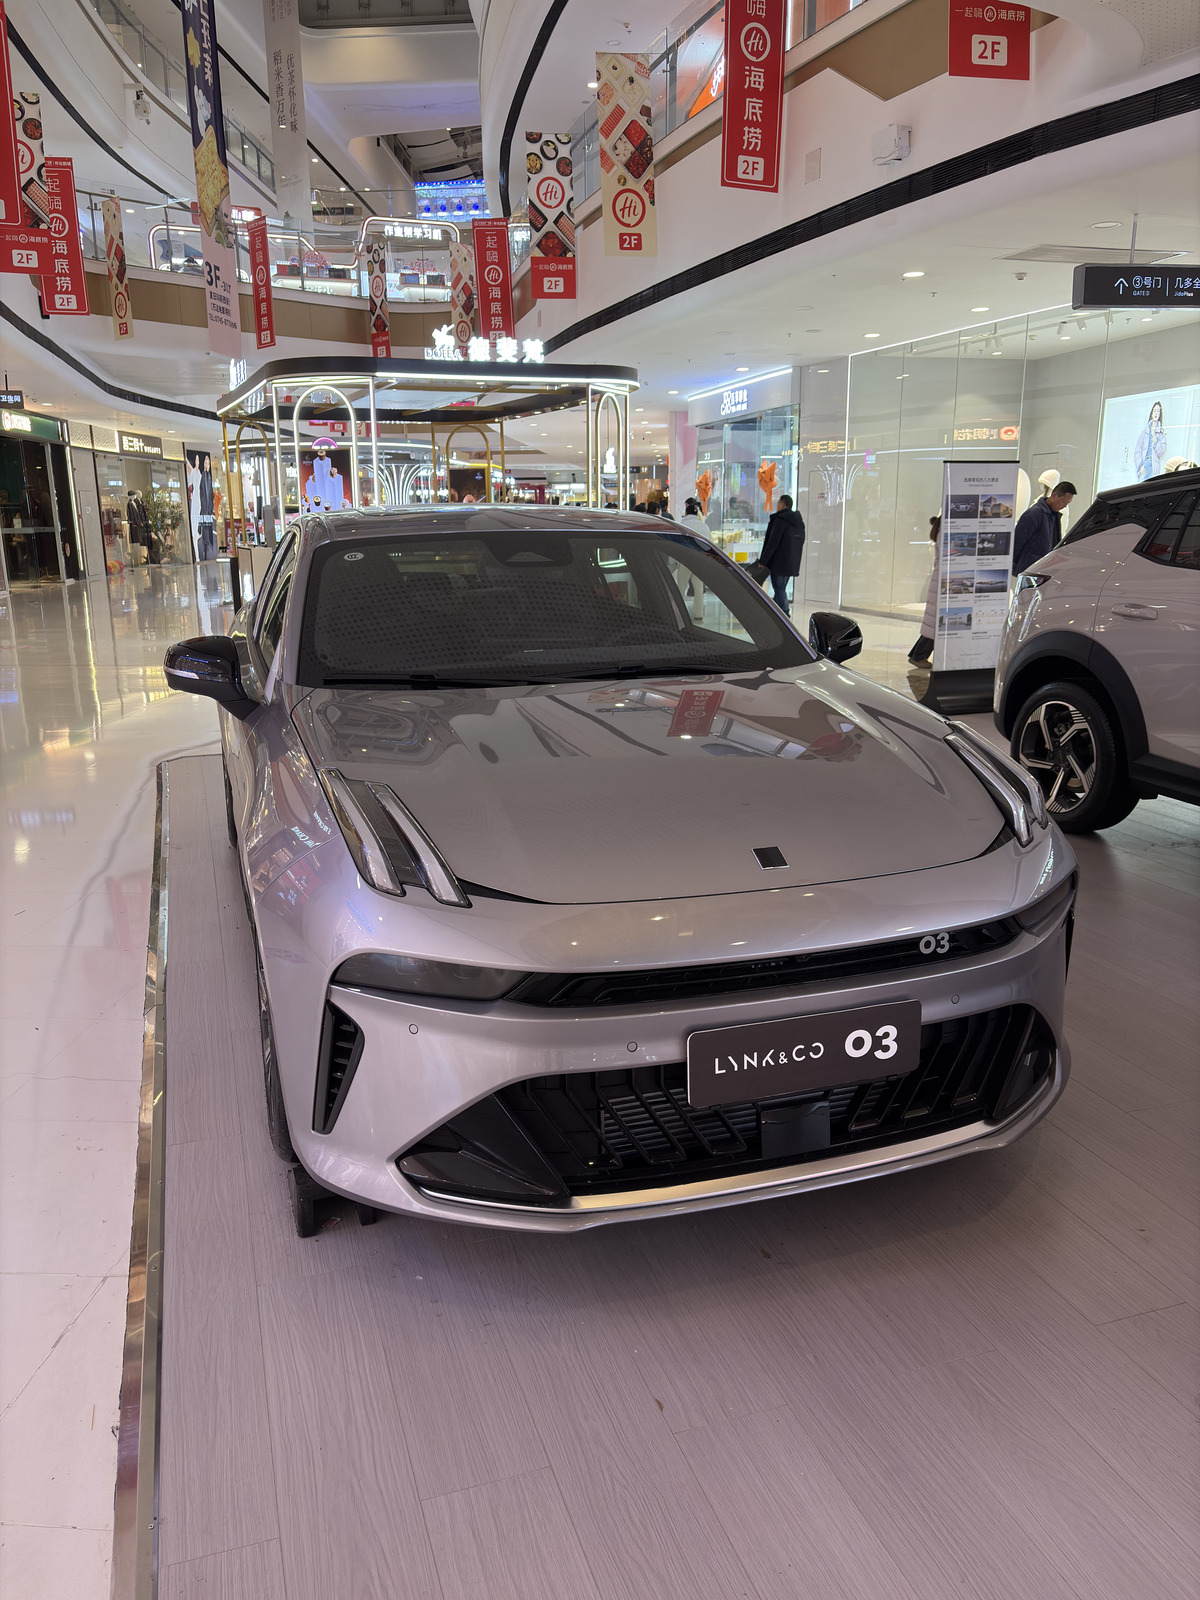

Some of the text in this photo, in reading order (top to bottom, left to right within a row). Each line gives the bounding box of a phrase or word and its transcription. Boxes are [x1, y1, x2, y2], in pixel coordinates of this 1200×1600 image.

[955, 7, 983, 18] 一起嗨
[998, 9, 1026, 21] 海底捞
[747, 30, 764, 52] Hi
[977, 39, 1001, 60] 2F
[743, 65, 765, 151] 海底捞
[742, 160, 760, 176] 2F
[46, 172, 62, 211] 一起嗨
[542, 183, 559, 202] Hi
[619, 196, 639, 219] Hi
[50, 220, 64, 231] Hi
[484, 231, 499, 263] 一起嗨
[622, 235, 638, 248] 2F
[16, 252, 33, 264] 2F
[52, 239, 72, 292] 海底捞
[488, 269, 499, 280] Hi
[547, 279, 560, 290] 2F
[58, 297, 73, 307] 2F
[258, 287, 269, 329] 海底捞
[488, 286, 503, 329] 海底捞
[119, 324, 127, 335] 2F
[262, 332, 269, 343] 2F
[0, 395, 21, 404] 卫生间
[919, 932, 950, 955] 03
[714, 1024, 898, 1075] LYNK&CO 03
